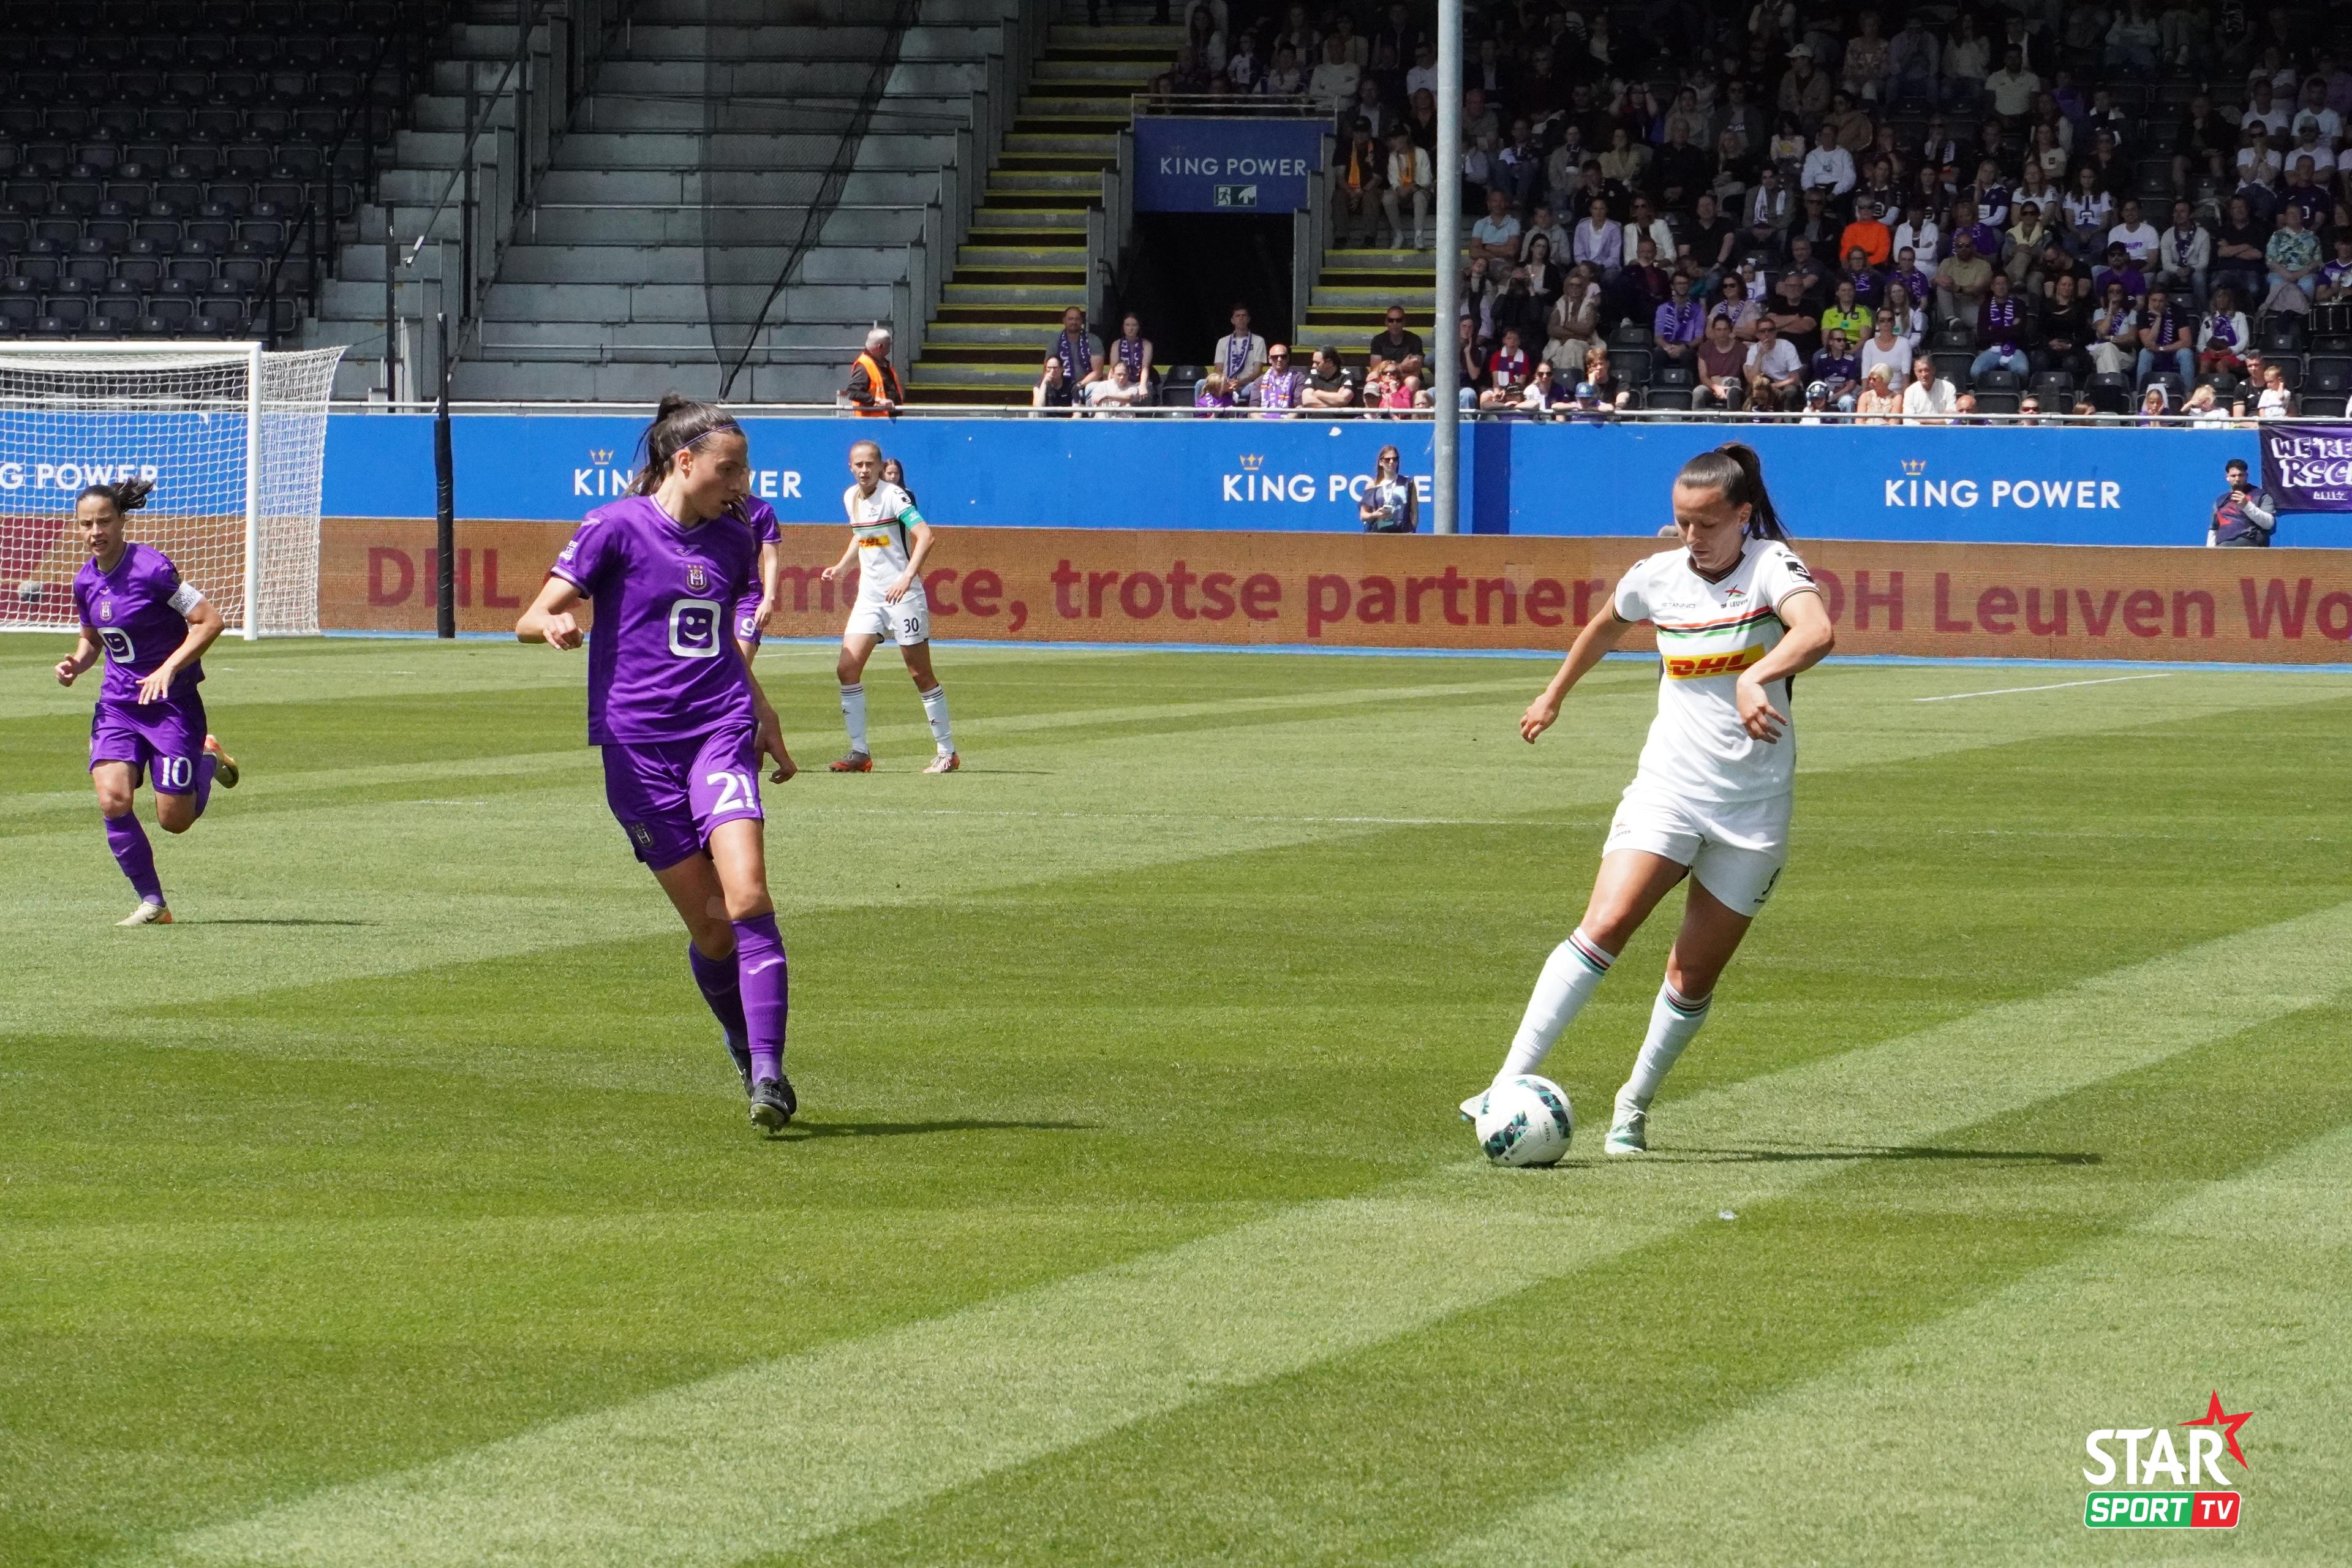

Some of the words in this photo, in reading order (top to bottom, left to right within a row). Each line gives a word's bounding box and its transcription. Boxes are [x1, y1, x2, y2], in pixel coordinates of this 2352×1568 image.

[1161, 157, 1219, 175] KING
[1227, 159, 1306, 176] POWER
[574, 469, 635, 496] KIN
[2279, 459, 2352, 488] RSC
[1223, 474, 1316, 502] KING
[1329, 475, 1431, 502] POE
[1885, 480, 1978, 508] KING
[1992, 480, 2121, 509] POWER
[368, 547, 519, 609] DHL
[1050, 559, 1282, 622] trotse
[1306, 565, 1605, 638] partner
[1935, 573, 2214, 638] Leuven
[739, 617, 755, 637] 9
[903, 617, 919, 633] 30
[1666, 653, 1753, 676] DHL
[161, 756, 192, 787] 10
[706, 772, 757, 815] 21
